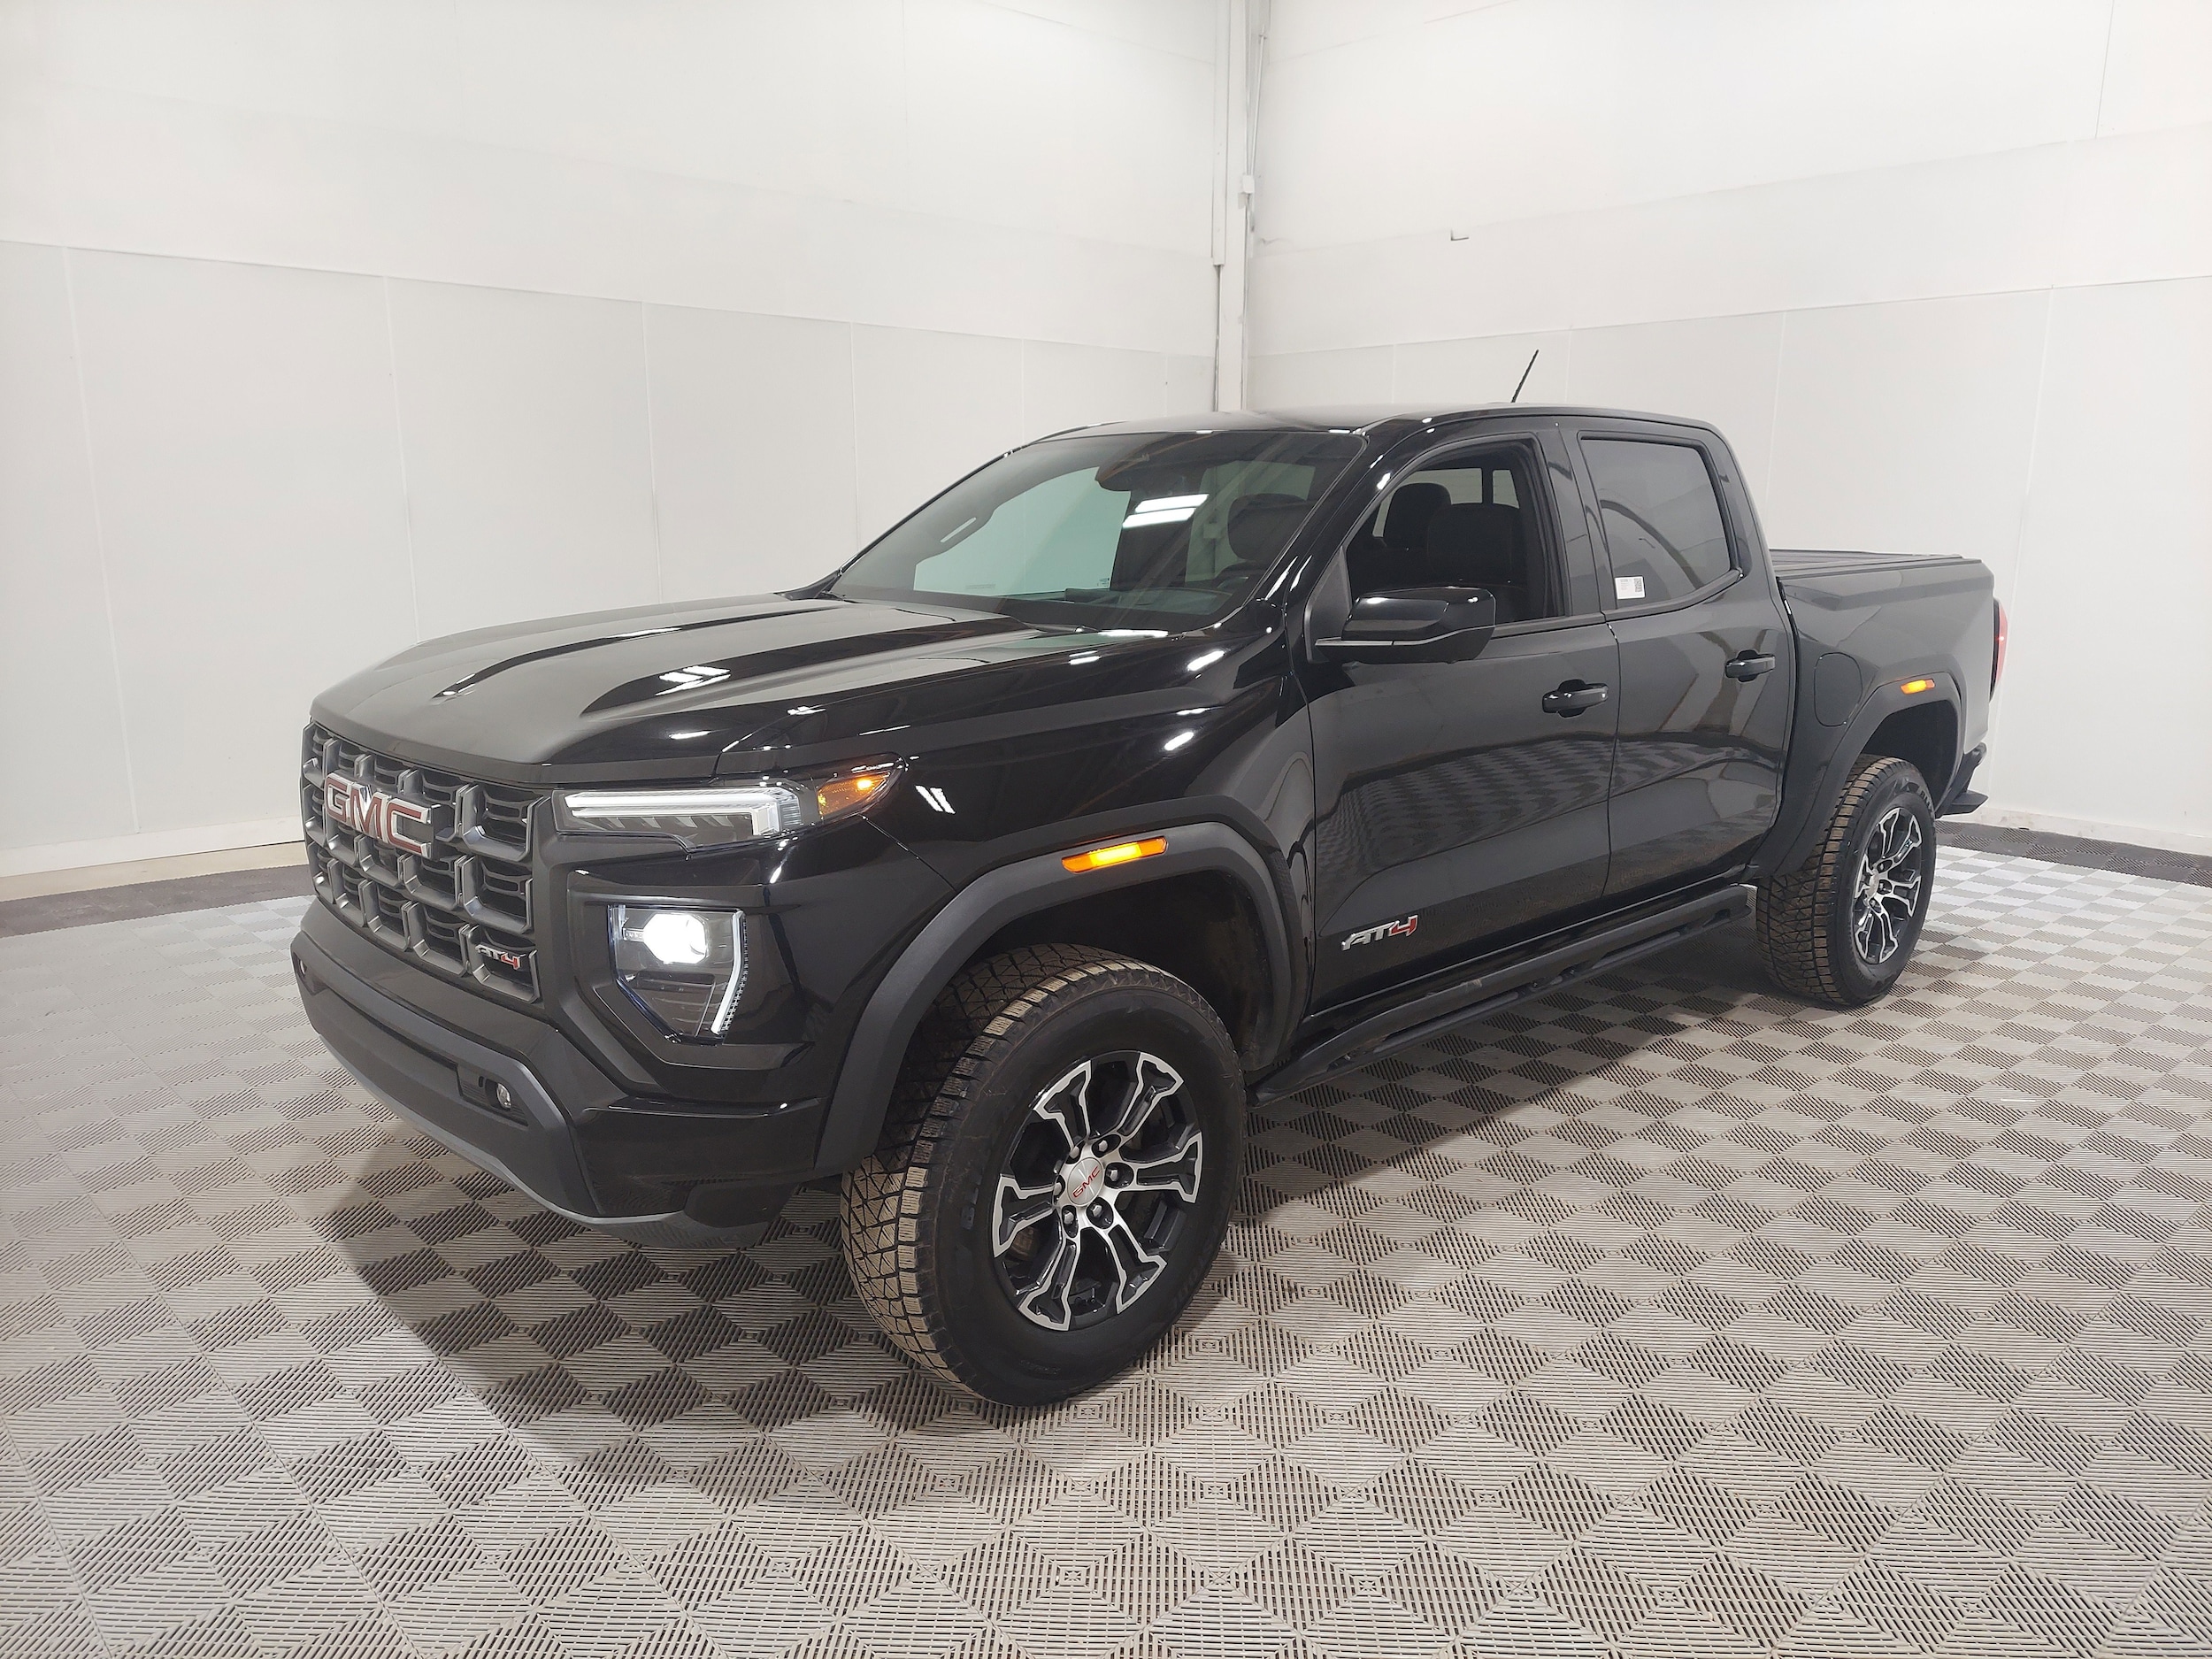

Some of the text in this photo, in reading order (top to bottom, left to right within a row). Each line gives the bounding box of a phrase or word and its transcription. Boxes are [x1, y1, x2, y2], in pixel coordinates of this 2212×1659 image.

[324, 772, 431, 859] GMC
[1341, 914, 1417, 950] AT4
[475, 944, 520, 970] AT4
[1072, 1165, 1101, 1198] GMC
